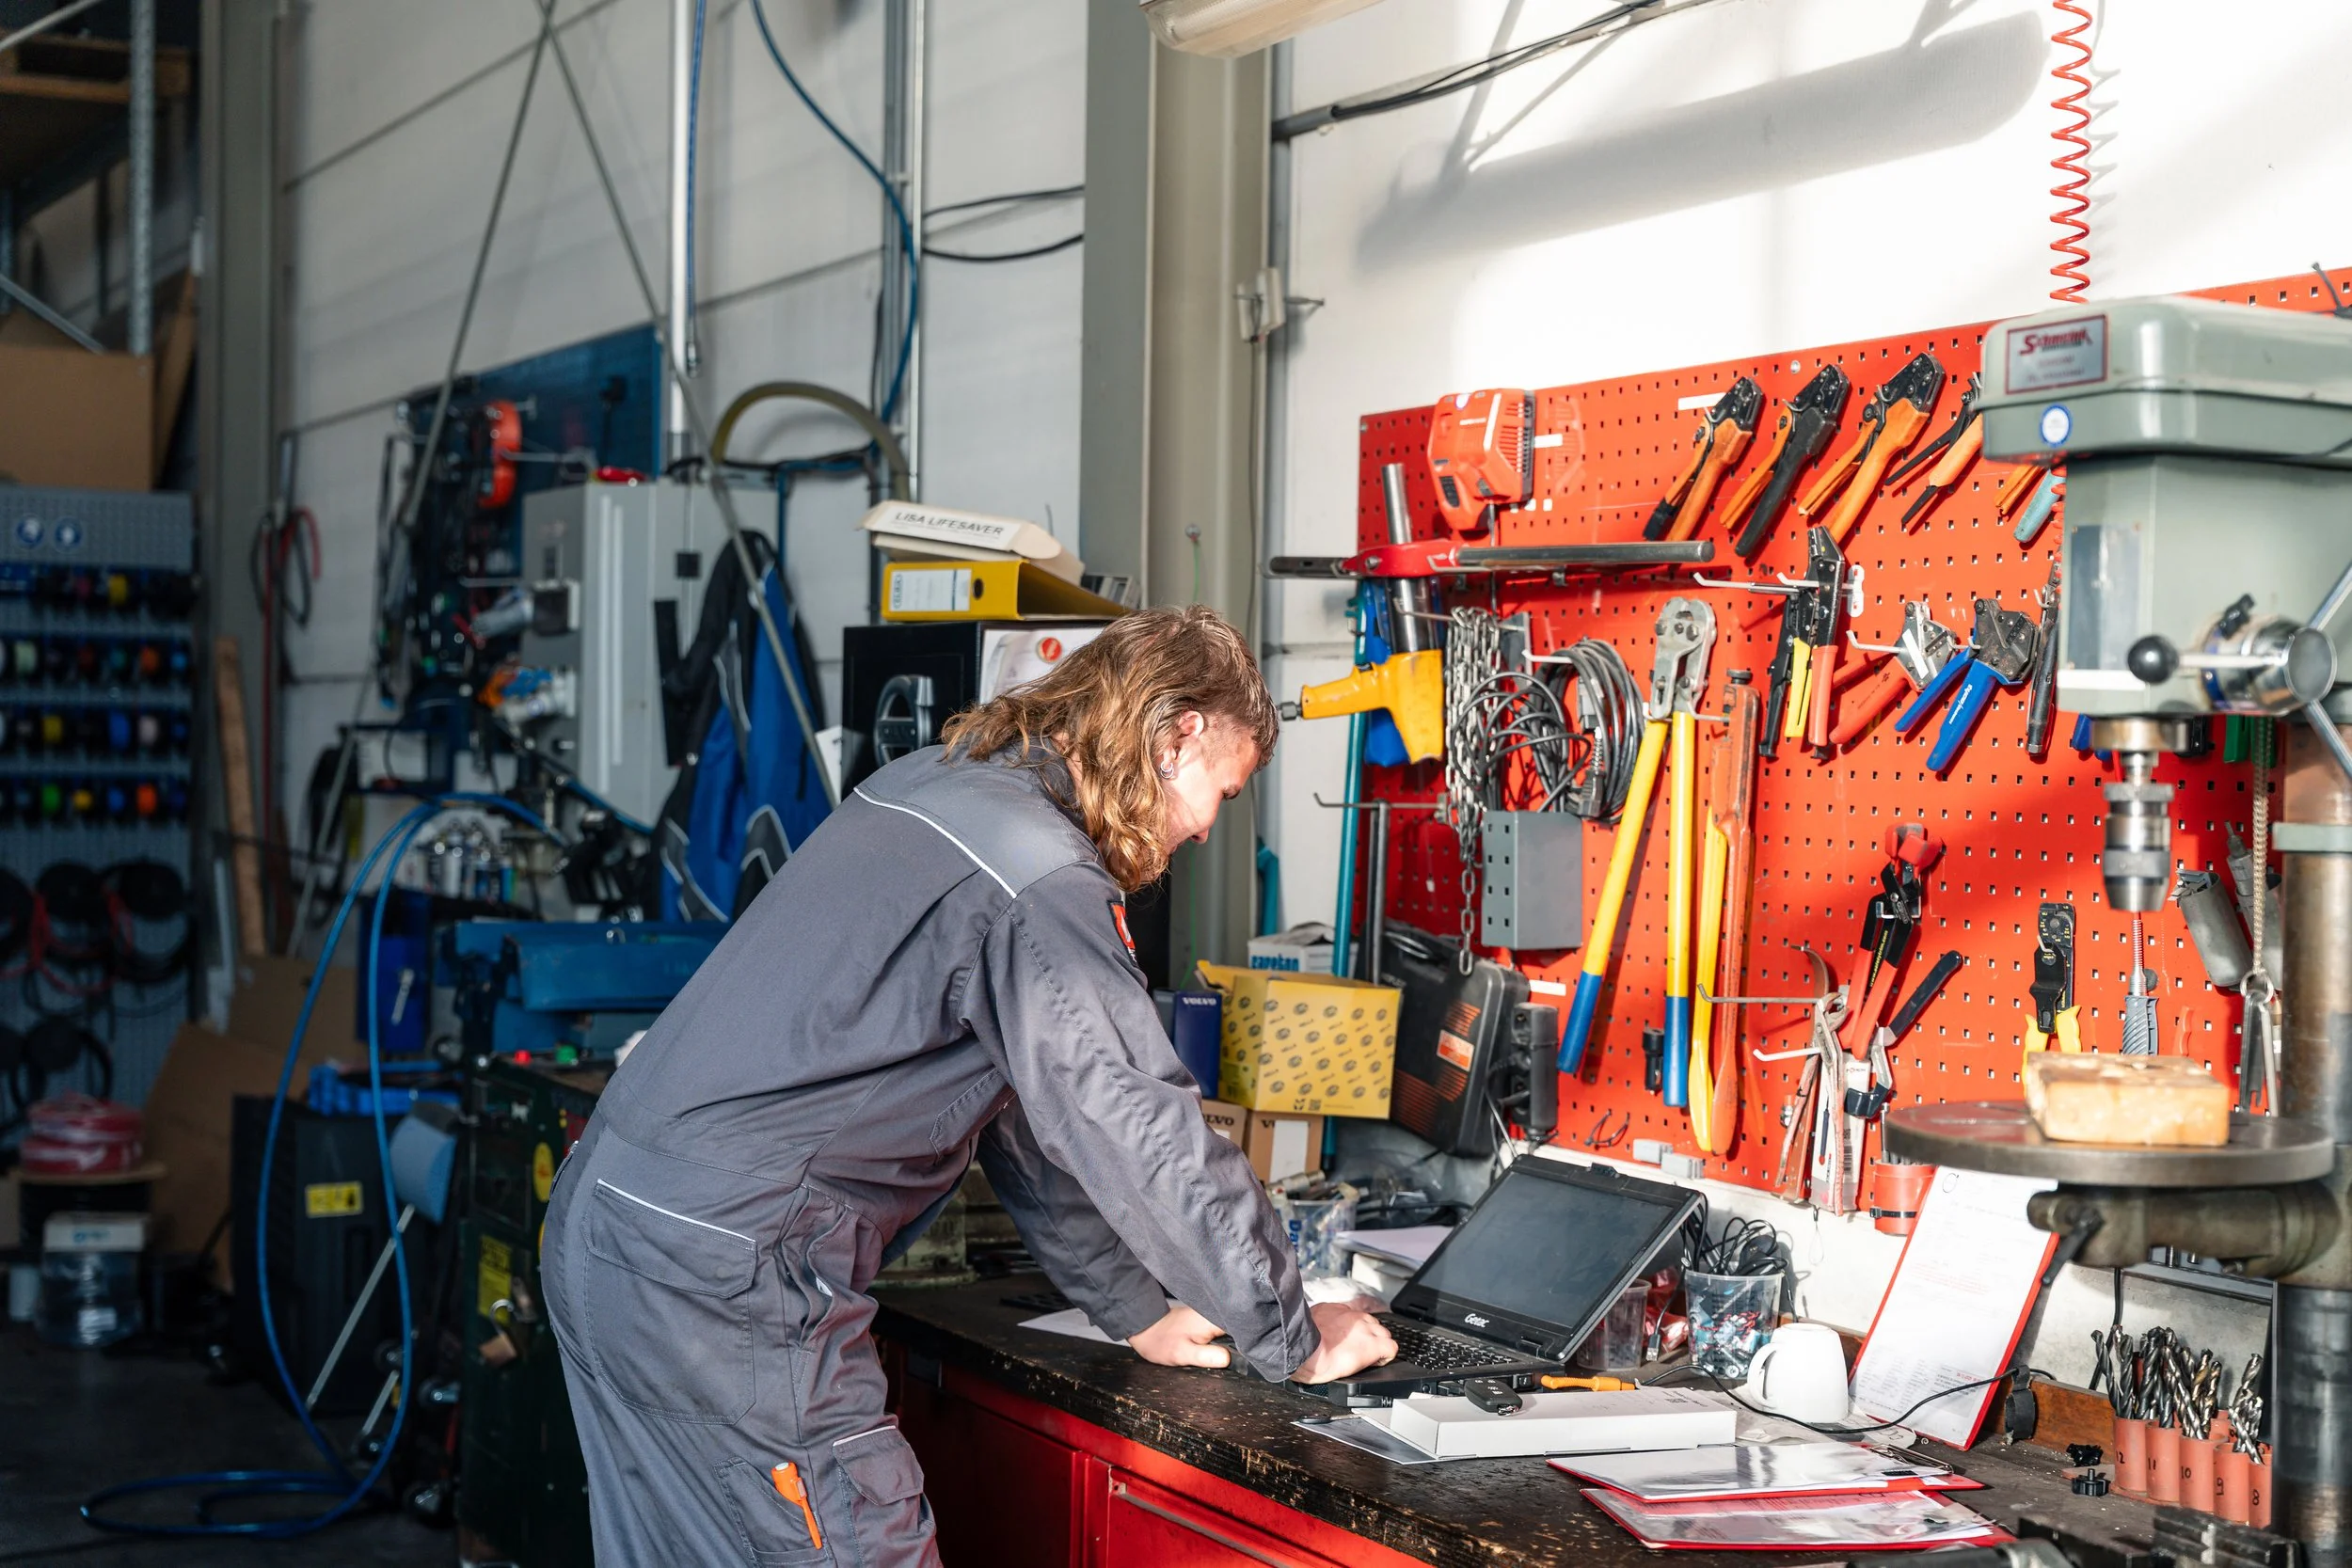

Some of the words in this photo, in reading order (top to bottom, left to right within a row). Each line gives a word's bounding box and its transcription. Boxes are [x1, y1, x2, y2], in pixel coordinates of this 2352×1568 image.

[896, 513, 926, 524] LISA
[928, 517, 1005, 535] LIFESAVER
[1182, 997, 1217, 1006] VOLVO
[1203, 1115, 1235, 1126] LVO
[1465, 1313, 1490, 1327] Getac
[2116, 1450, 2125, 1464] 12
[2148, 1458, 2156, 1470] 11
[2181, 1465, 2191, 1479] 10
[2252, 1489, 2260, 1506] 8
